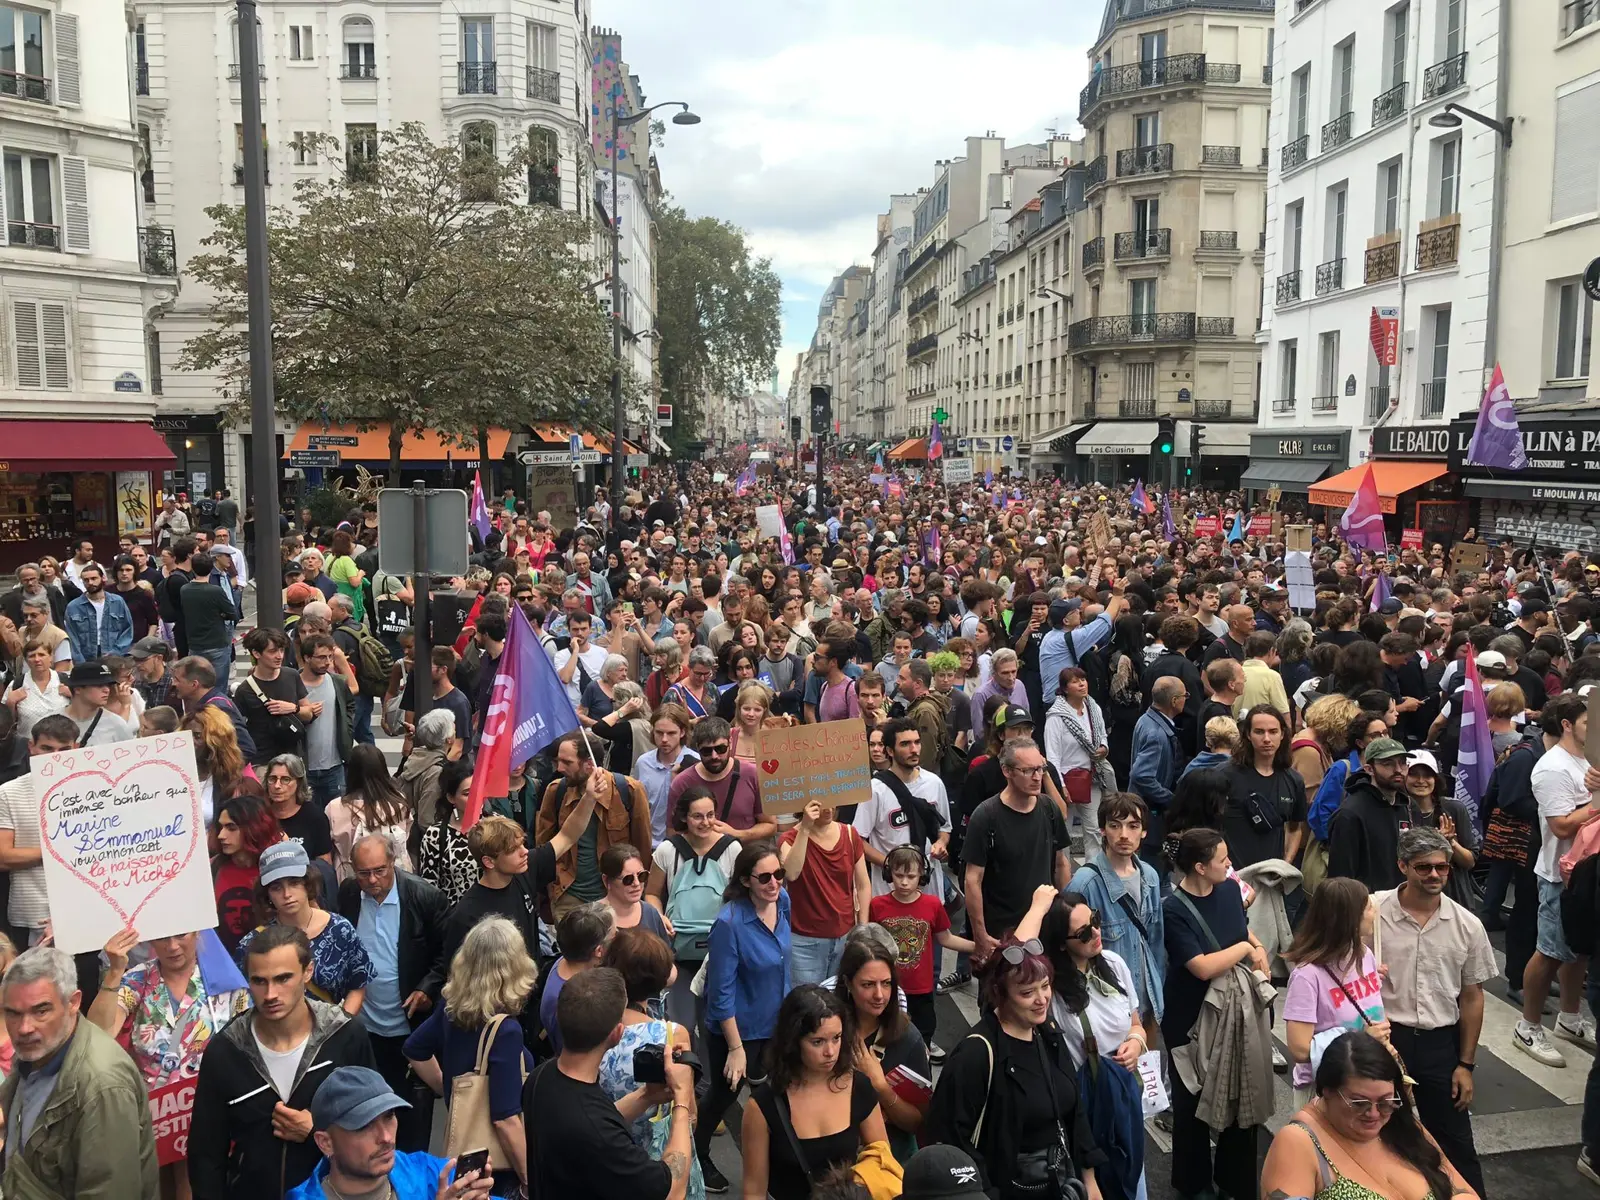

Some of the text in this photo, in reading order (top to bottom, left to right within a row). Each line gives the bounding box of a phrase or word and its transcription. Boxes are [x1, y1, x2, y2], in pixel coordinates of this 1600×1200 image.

[1386, 322, 1396, 362] TABAC
[154, 420, 188, 430] GENCY
[1390, 430, 1450, 452] LE BALTO
[1564, 430, 1576, 452] à
[1312, 490, 1354, 507] MADEMOISELL
[1532, 488, 1542, 497] LE
[1544, 489, 1576, 499] MOULIN
[763, 778, 779, 788] ON
[784, 776, 805, 786] EST
[48, 784, 140, 812] C'est avec un
[59, 787, 188, 819] immense bonheur que
[782, 790, 804, 801] SERA
[49, 813, 122, 841] Marine
[89, 850, 178, 877] la naissance
[103, 862, 181, 890] de Michel
[1329, 970, 1380, 1008] PEIXE
[950, 1166, 976, 1175] Reebok
